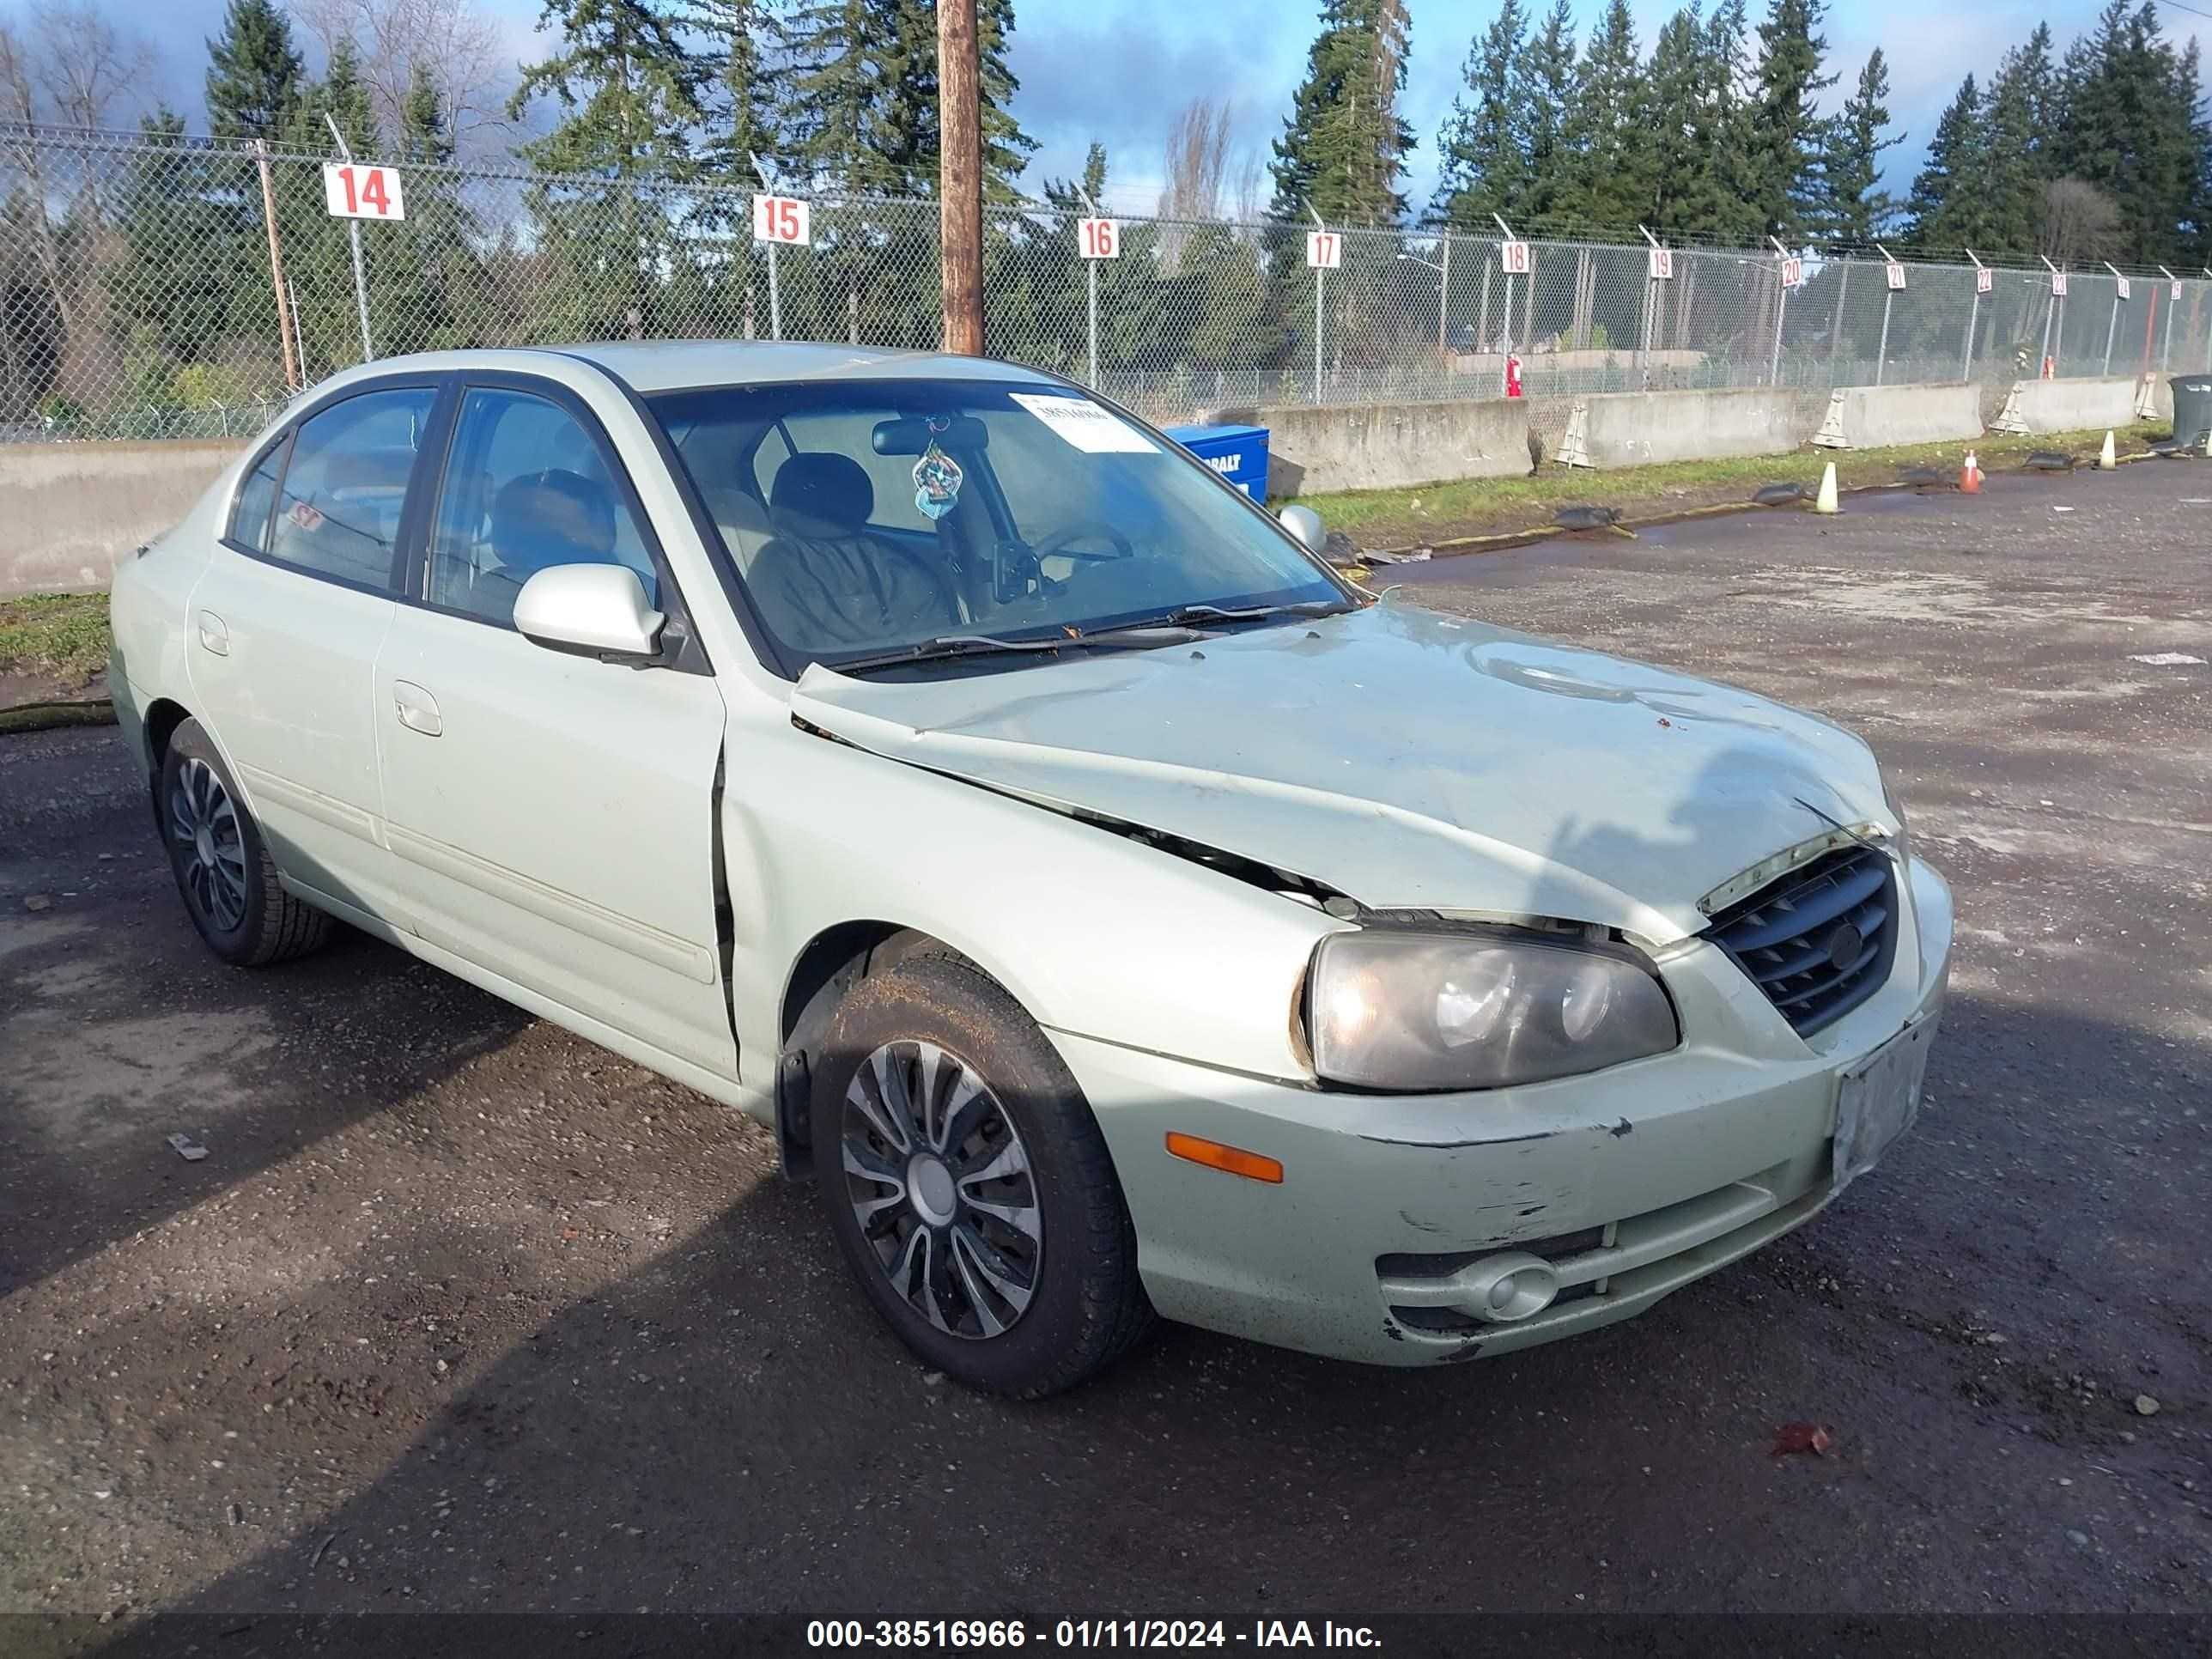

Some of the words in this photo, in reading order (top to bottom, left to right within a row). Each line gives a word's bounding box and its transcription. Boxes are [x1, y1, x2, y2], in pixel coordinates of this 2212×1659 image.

[339, 167, 390, 215] 14
[765, 199, 799, 240] 15
[1086, 222, 1112, 255] 16
[1316, 235, 1333, 264] 17
[1508, 245, 1523, 270] 18
[1655, 252, 1668, 275] 19
[1784, 260, 1800, 283] 20
[1890, 267, 1902, 286] 21
[1978, 270, 1990, 290] 22
